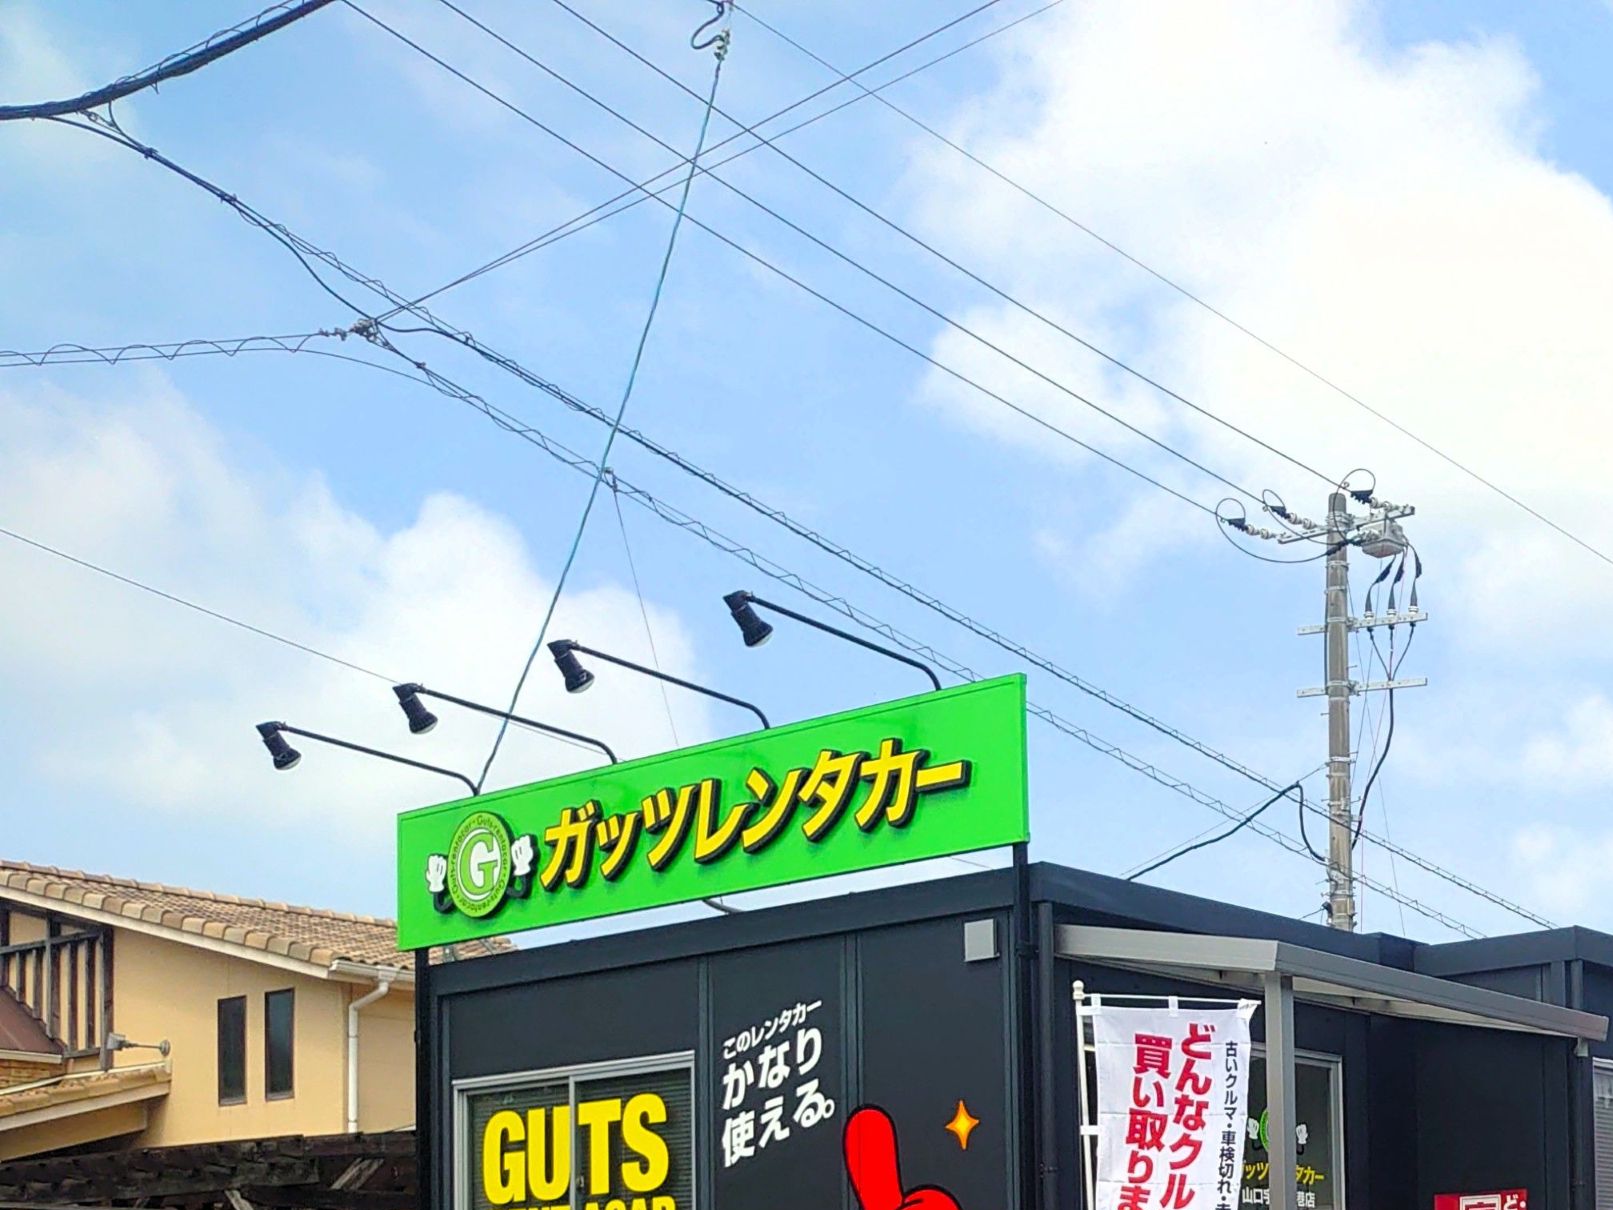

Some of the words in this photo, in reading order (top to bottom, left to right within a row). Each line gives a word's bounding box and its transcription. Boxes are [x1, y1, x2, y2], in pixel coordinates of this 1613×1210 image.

[541, 738, 972, 892] ガッツレンタカー
[460, 832, 499, 897] G
[722, 1027, 823, 1110] かなり
[723, 999, 823, 1060] このレンタカー
[482, 1092, 669, 1206] GUTS
[721, 1078, 836, 1168] 使える。
